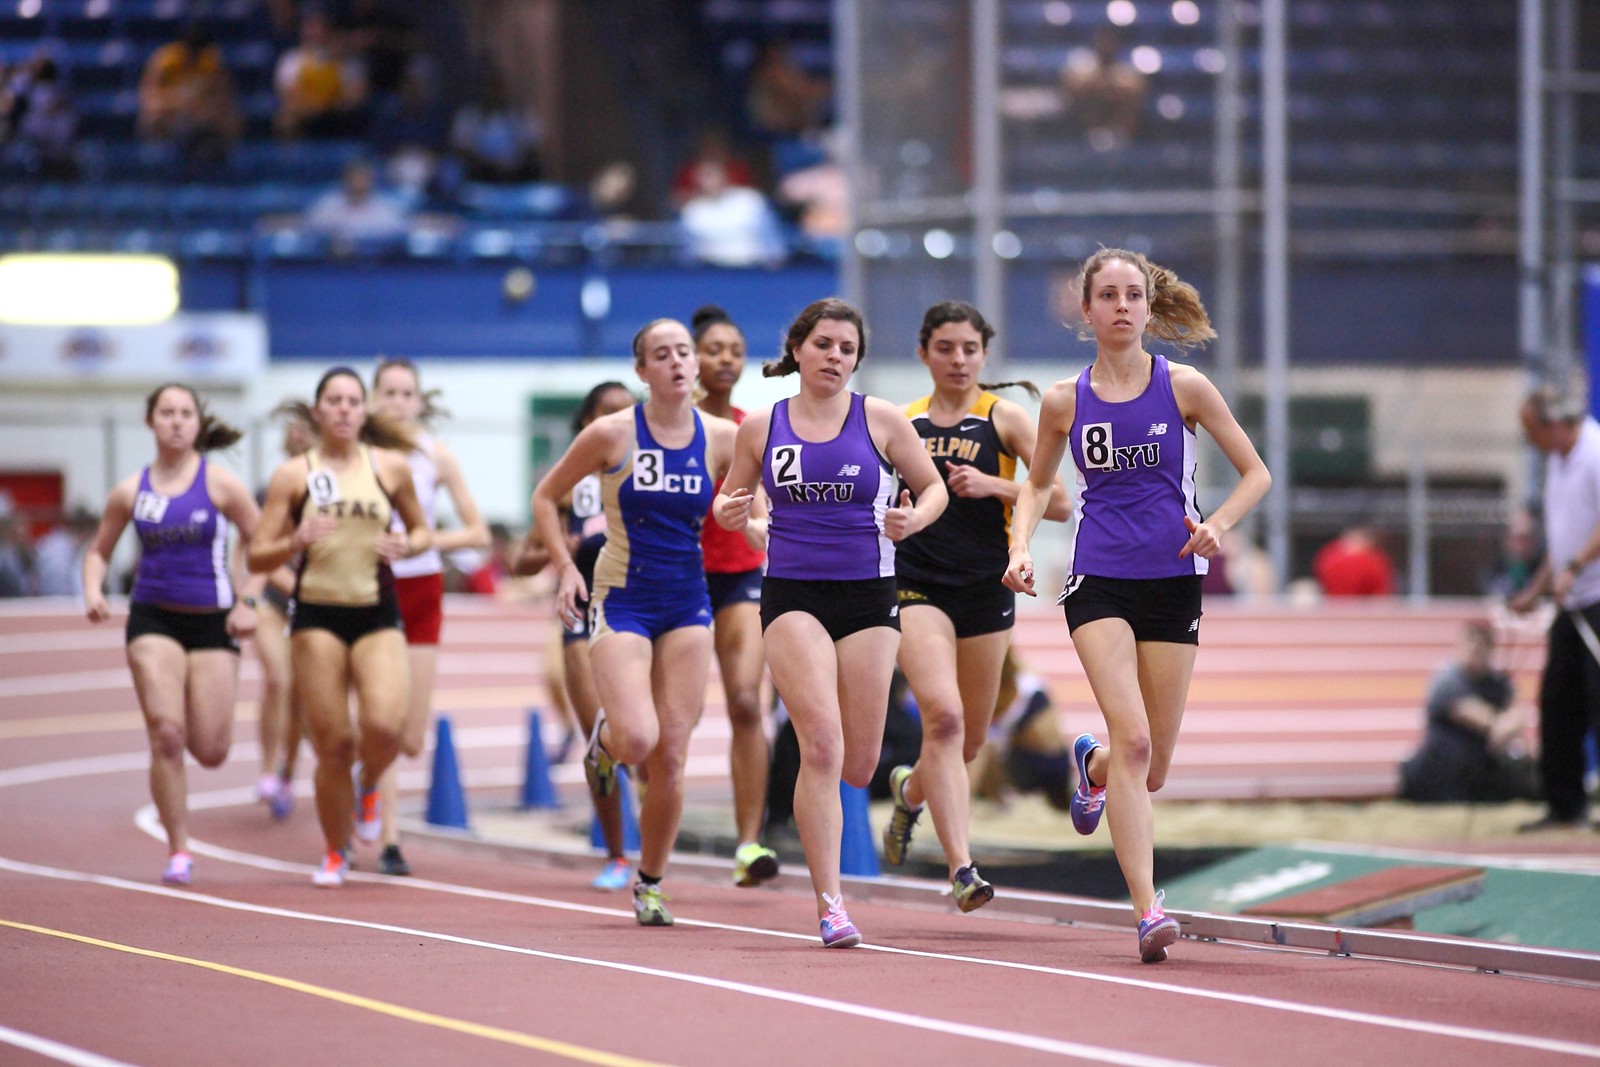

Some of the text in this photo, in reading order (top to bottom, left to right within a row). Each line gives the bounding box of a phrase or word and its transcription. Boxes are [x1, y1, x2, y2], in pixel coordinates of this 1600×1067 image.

[1086, 426, 1108, 465] 8
[638, 453, 658, 486] 3
[775, 447, 797, 484] 2
[314, 473, 332, 504] 9
[579, 483, 594, 510] 6
[787, 482, 854, 502] NYU
